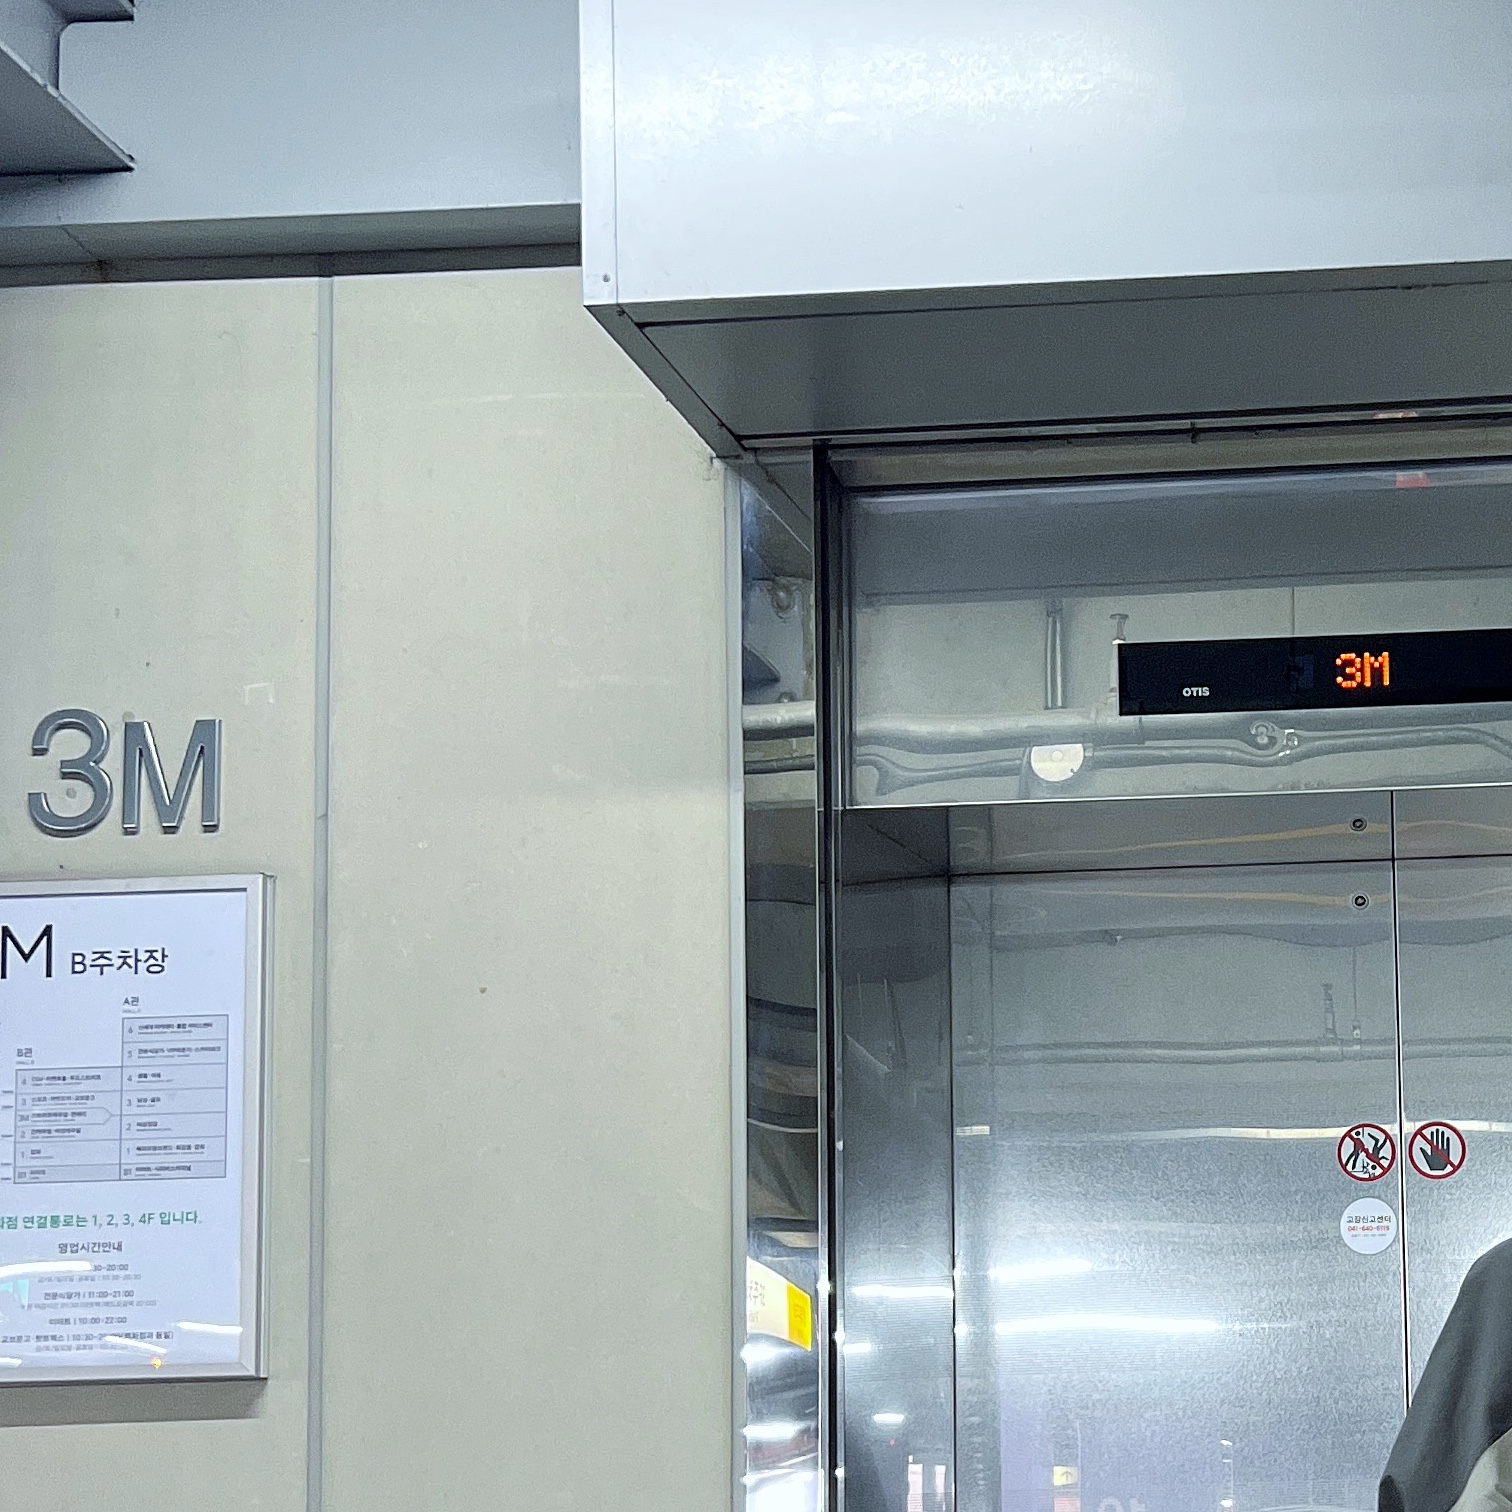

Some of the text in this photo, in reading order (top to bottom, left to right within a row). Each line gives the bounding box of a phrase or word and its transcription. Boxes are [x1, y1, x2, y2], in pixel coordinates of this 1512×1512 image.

[1335, 651, 1391, 688] 3M
[1182, 686, 1210, 697] OTIS
[28, 708, 222, 838] 3M
[71, 947, 168, 976] B주차장
[22, 1213, 89, 1229] 연결통로는
[138, 1212, 156, 1225] 4F
[58, 1241, 123, 1254] 영업시간안내
